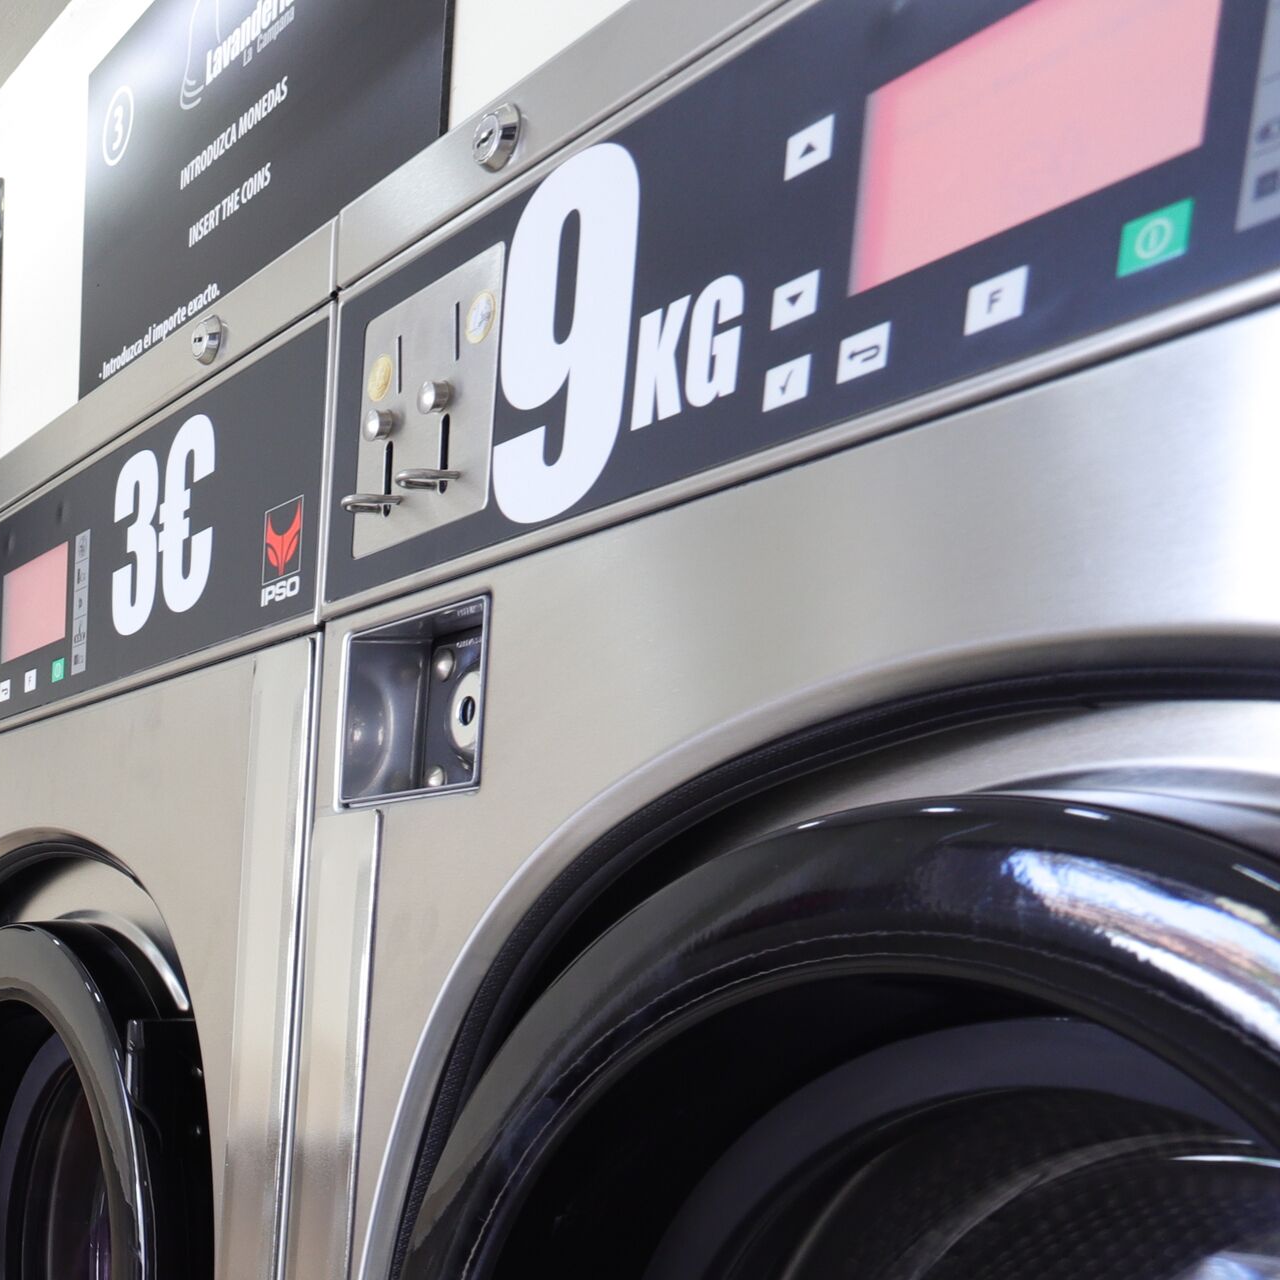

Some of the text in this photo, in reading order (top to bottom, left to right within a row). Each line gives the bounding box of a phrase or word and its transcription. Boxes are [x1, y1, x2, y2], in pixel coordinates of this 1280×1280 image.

[243, 46, 253, 67] La
[111, 104, 124, 152] 3
[180, 75, 288, 190] INTRODUZCA MONEDAS
[188, 162, 271, 248] INSERT THE COINS
[103, 345, 143, 380] Introduzca
[143, 326, 152, 349] el
[152, 306, 187, 341] importe
[187, 283, 220, 317] exacto.
[112, 413, 216, 636] 3€
[260, 575, 301, 608] IPSO
